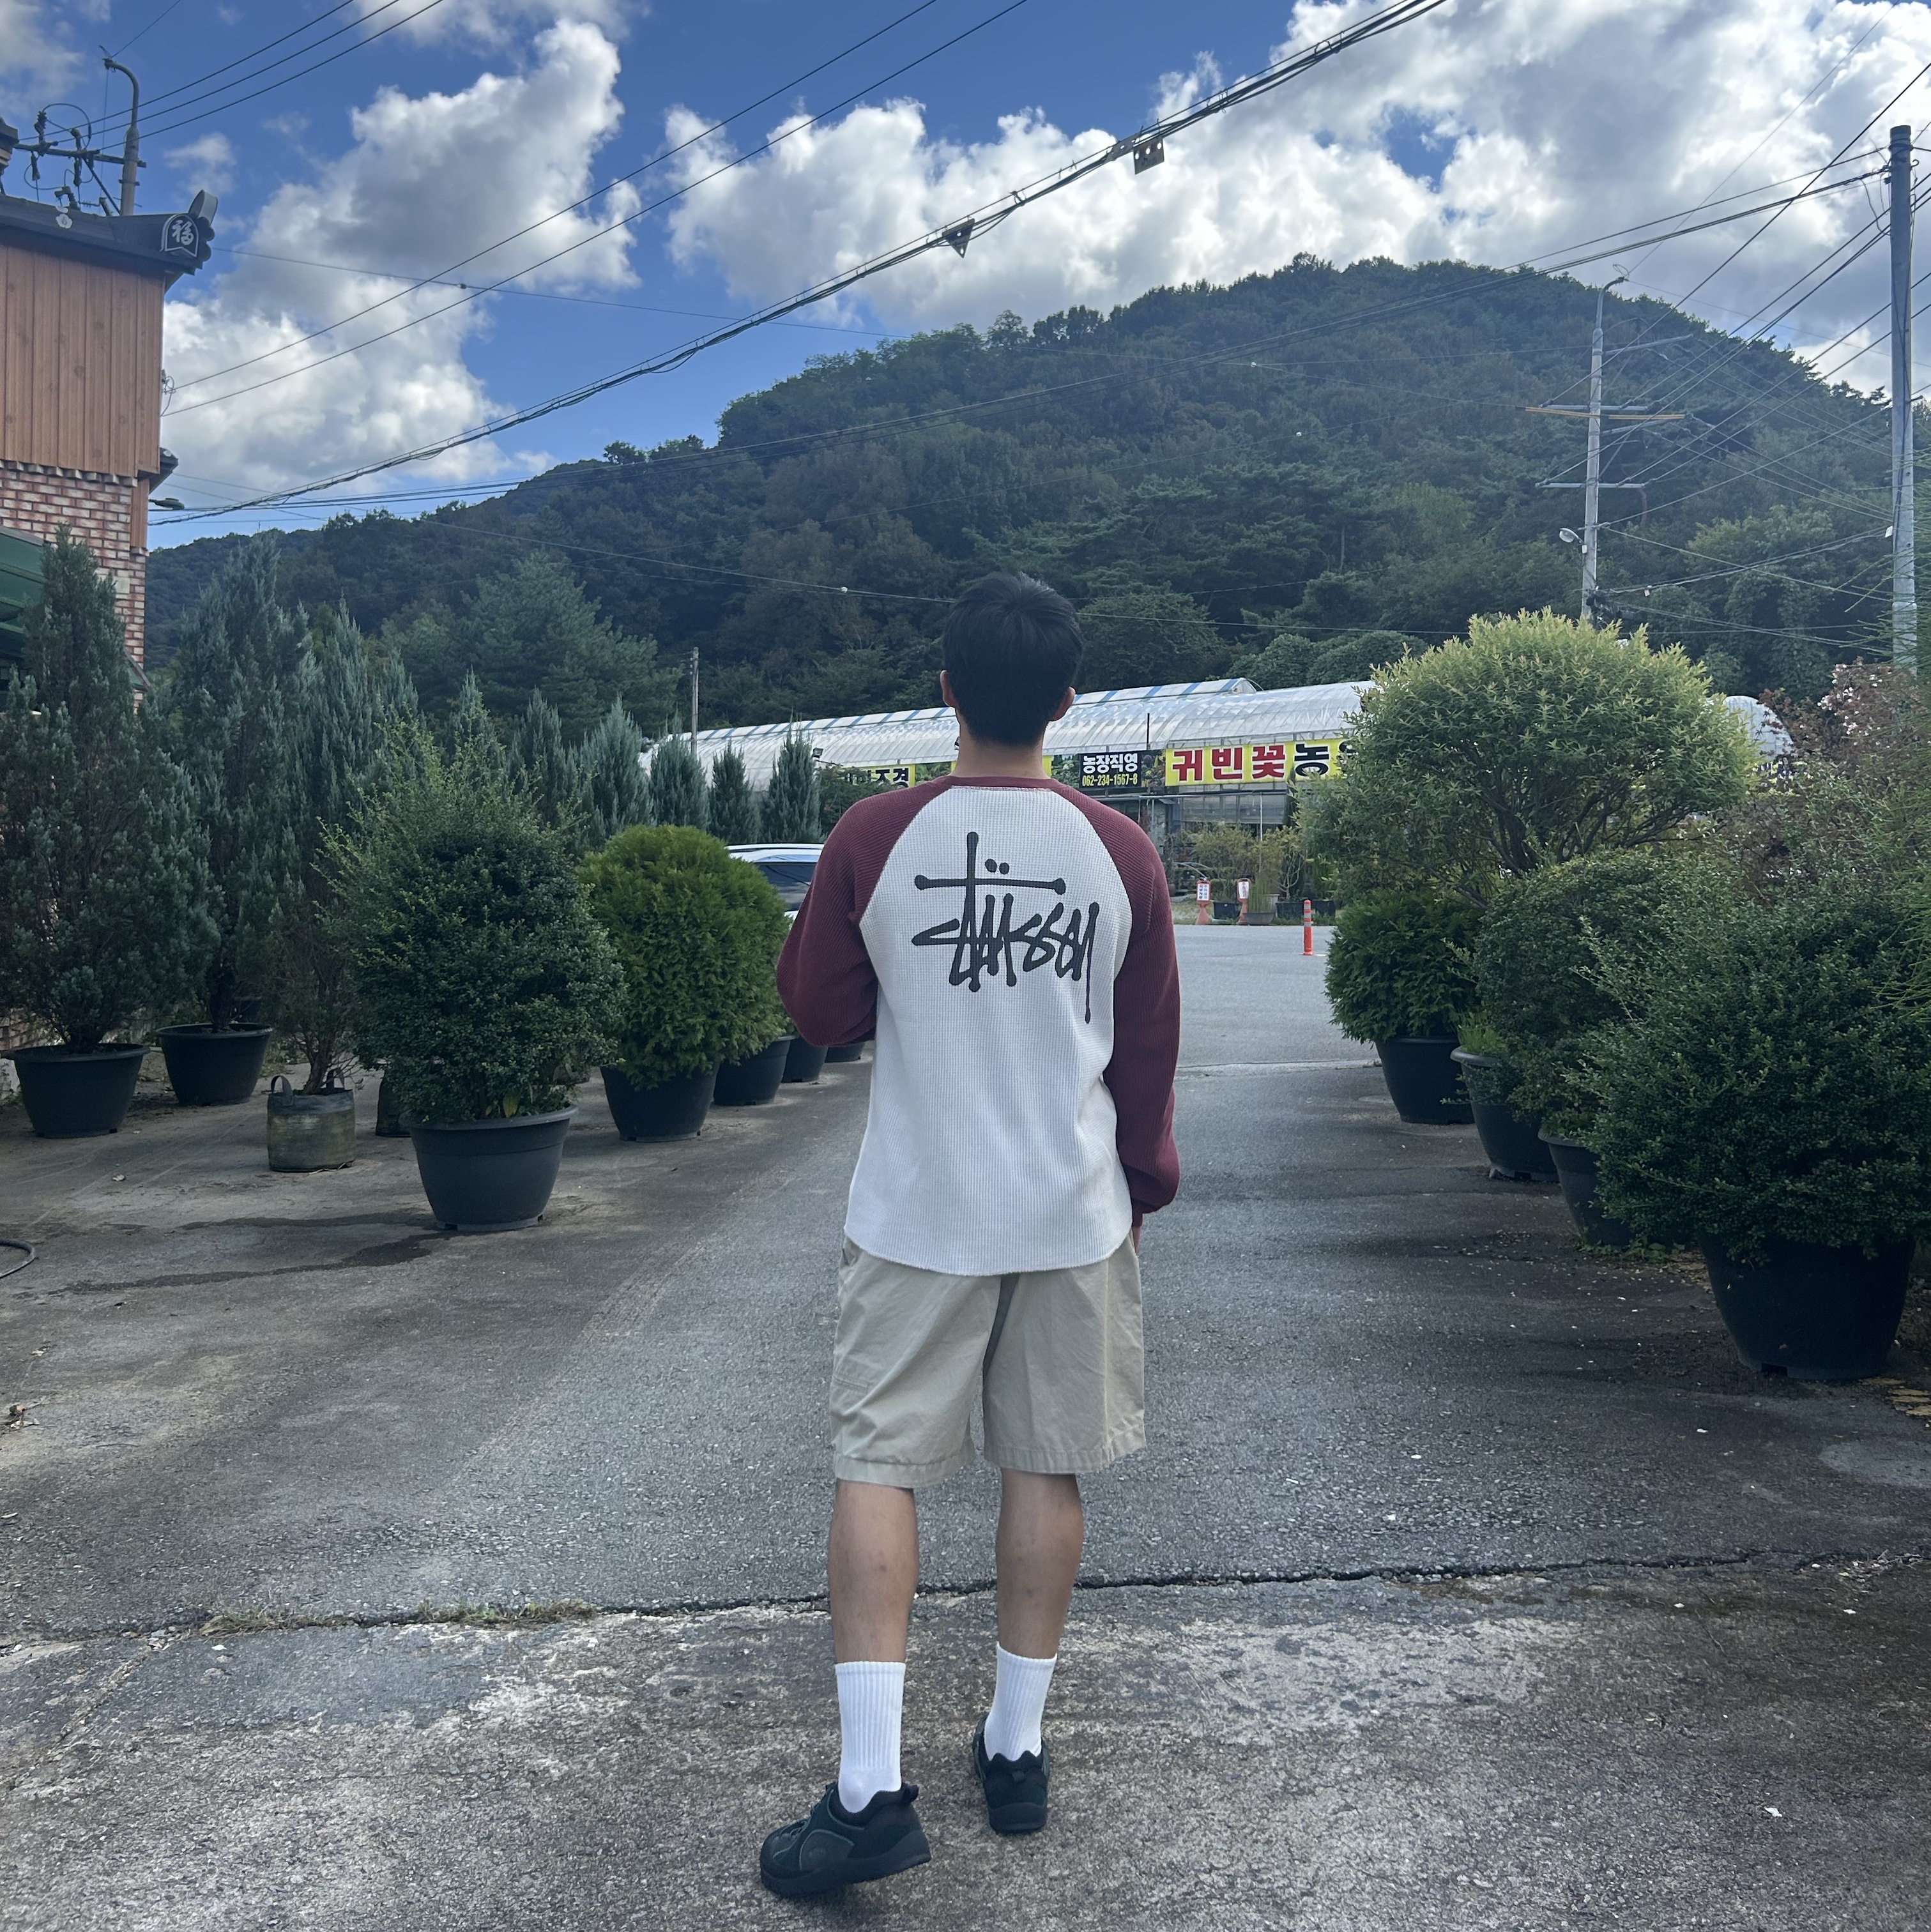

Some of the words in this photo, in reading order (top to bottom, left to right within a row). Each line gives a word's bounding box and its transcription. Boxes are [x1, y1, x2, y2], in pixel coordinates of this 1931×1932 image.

[172, 219, 194, 246] 福
[1083, 753, 1138, 774] 농장직영
[1082, 773, 1138, 786] 062-234-1567-8
